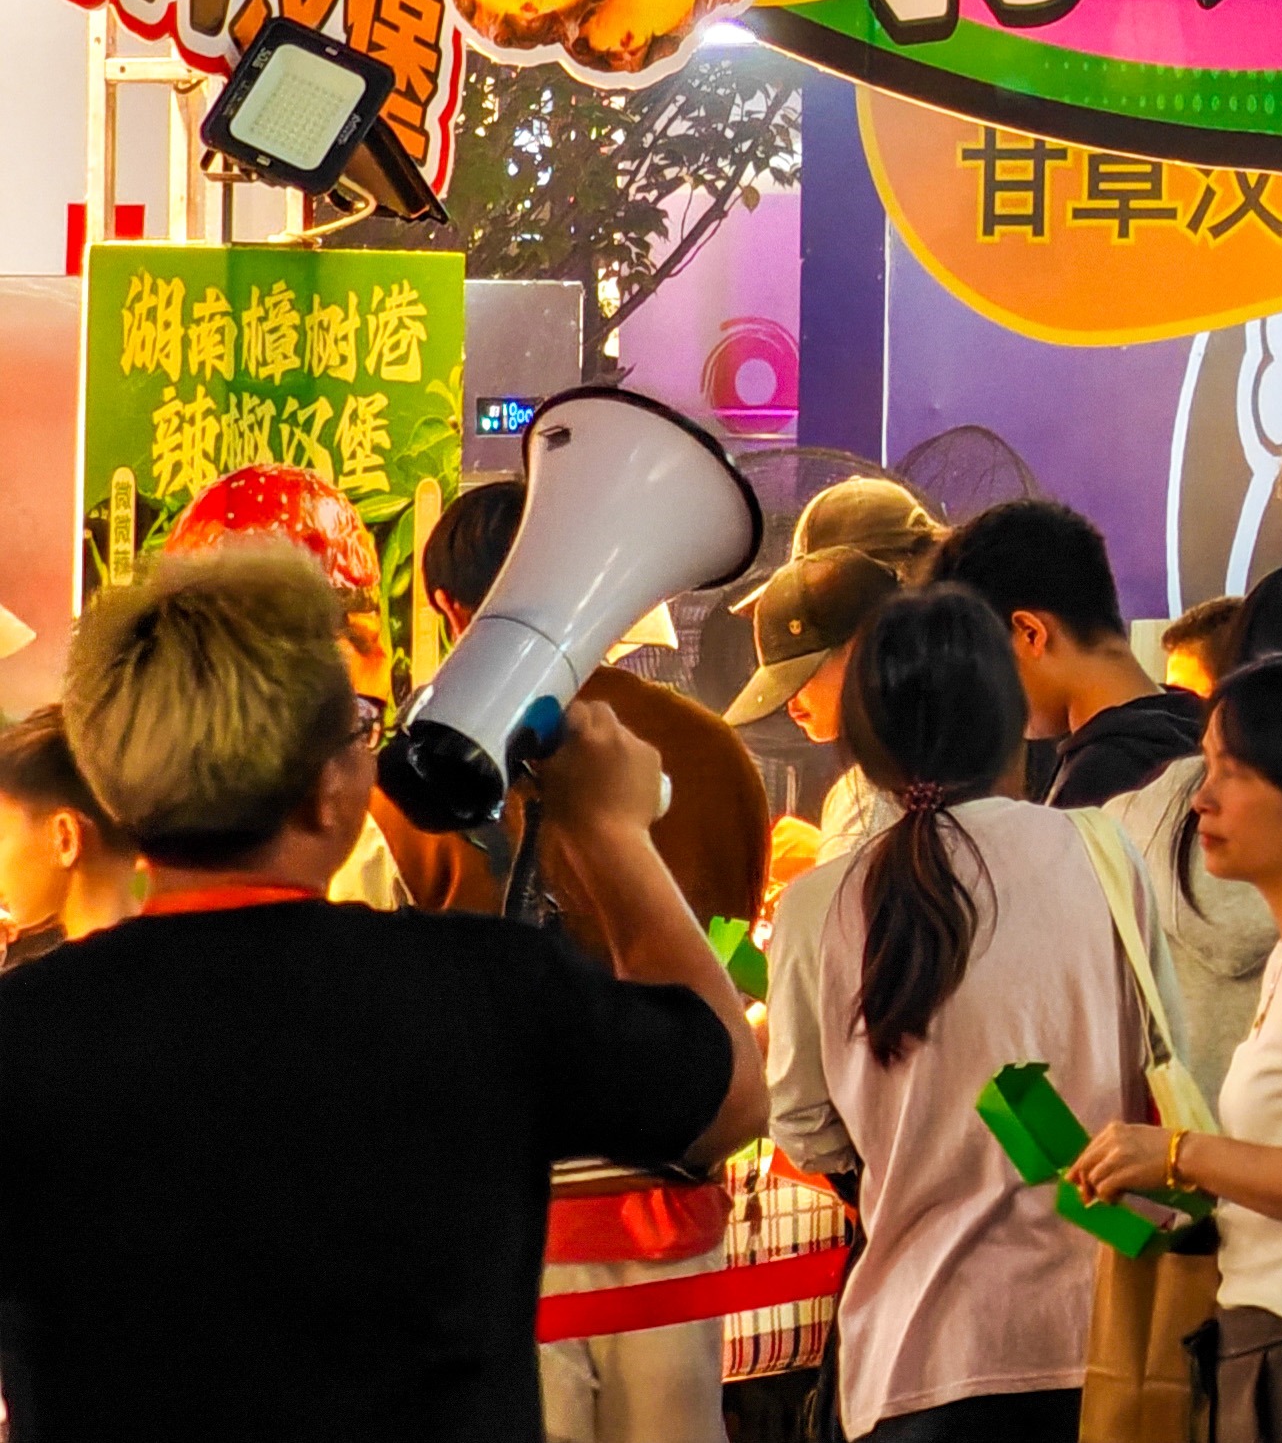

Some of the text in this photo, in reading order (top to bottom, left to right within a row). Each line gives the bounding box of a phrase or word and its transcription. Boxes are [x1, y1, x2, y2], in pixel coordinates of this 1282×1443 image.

[120, 268, 428, 386] 湖南樟树港
